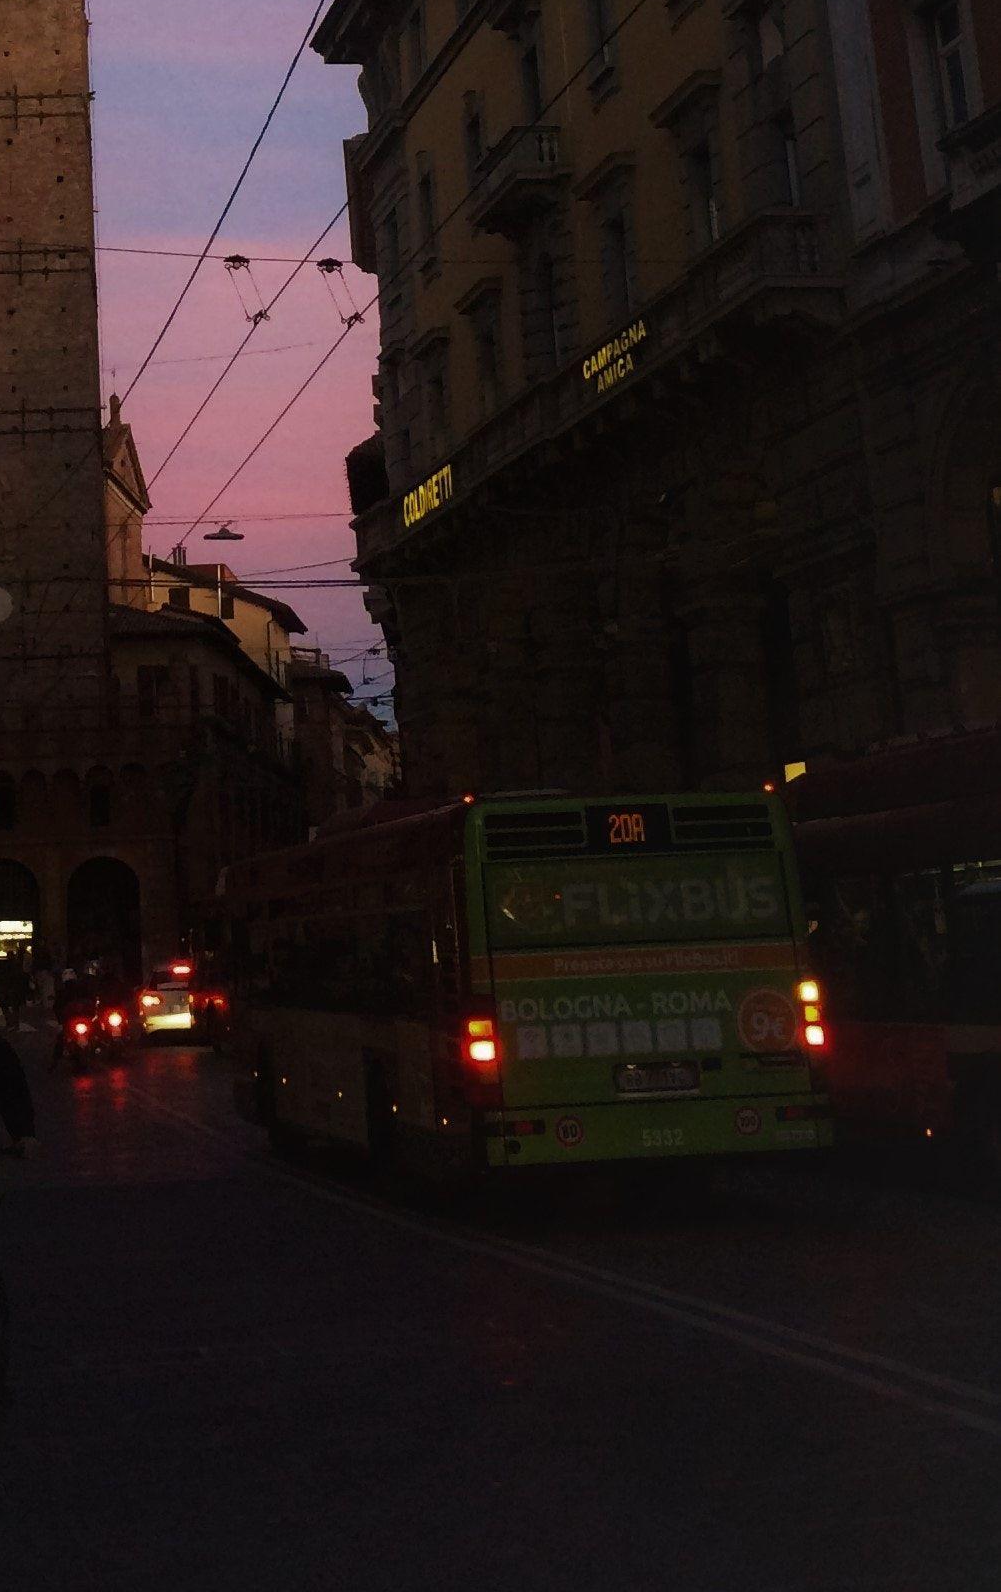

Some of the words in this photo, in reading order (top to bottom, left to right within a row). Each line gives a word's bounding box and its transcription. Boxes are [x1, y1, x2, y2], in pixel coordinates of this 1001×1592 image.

[582, 319, 647, 380] CAMPAGNA
[597, 353, 634, 394] AMICA
[403, 463, 453, 528] COLDIRETTI
[608, 813, 647, 844] 20A
[500, 993, 633, 1022] BOLOGNA
[652, 990, 733, 1014] ROMA
